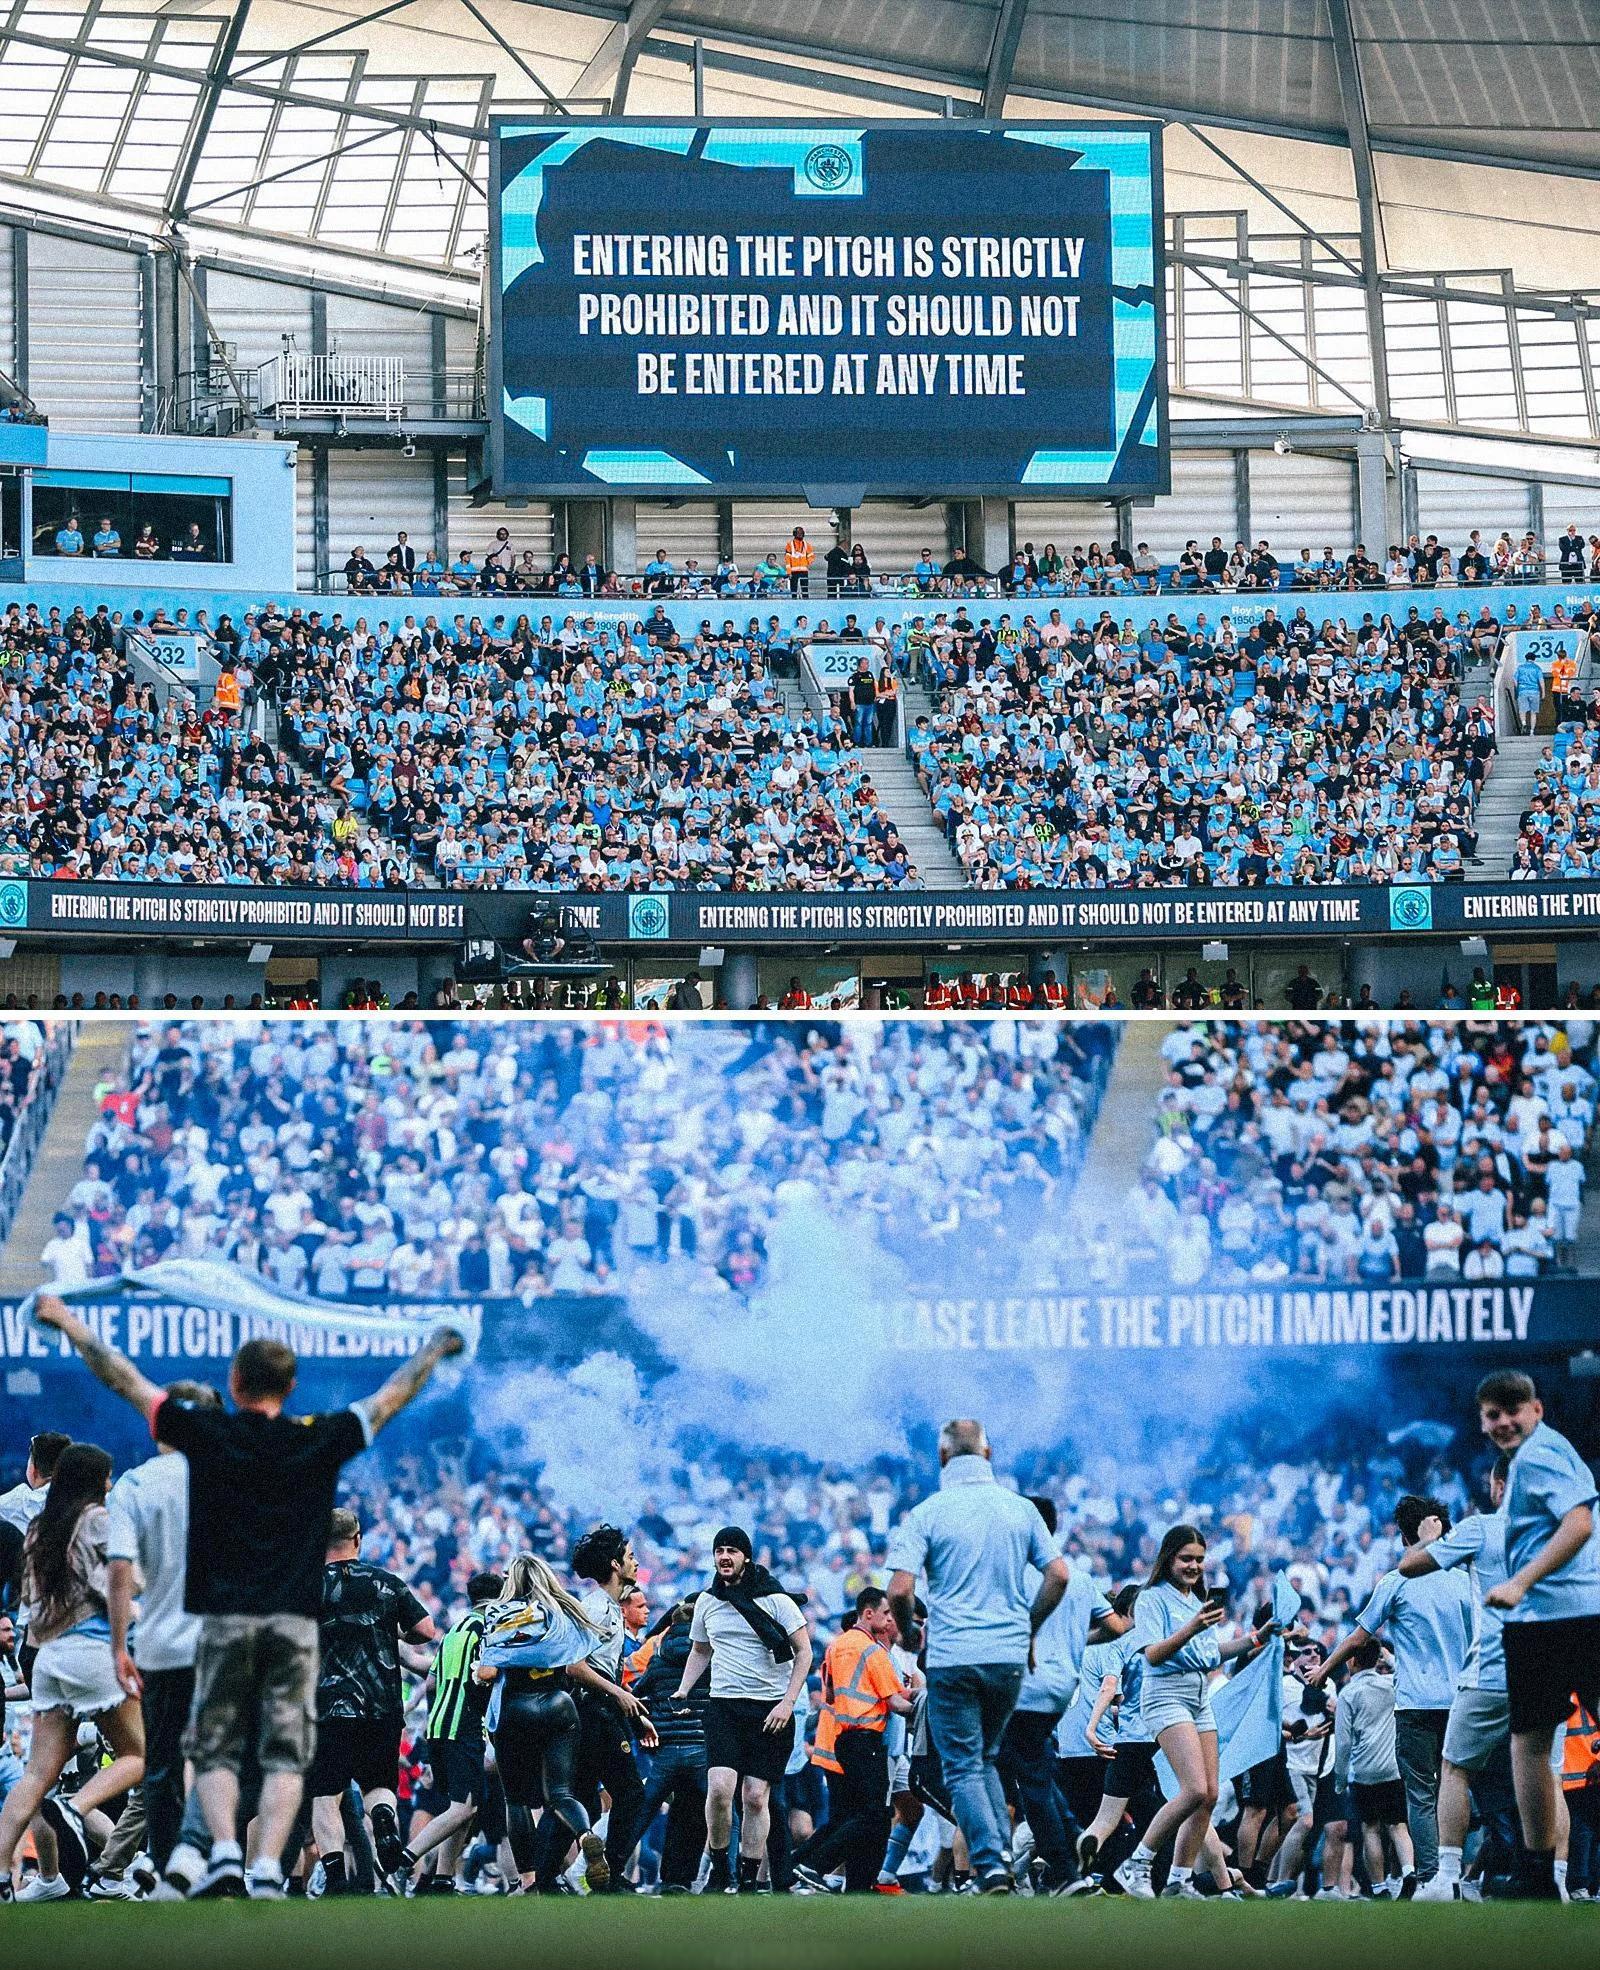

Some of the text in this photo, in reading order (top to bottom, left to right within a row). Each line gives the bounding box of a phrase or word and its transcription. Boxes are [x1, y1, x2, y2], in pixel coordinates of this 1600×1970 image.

[574, 235, 1084, 278] ENTERING THE PITCH IS STRICTLY
[578, 294, 1081, 338] PROHIBITED AND IT SHOULD NOT
[637, 353, 1026, 397] BE ENTERED AT ANY TIME
[152, 647, 185, 664] 232
[825, 656, 860, 672] 233
[1529, 641, 1564, 659] 234
[51, 894, 107, 919] ENTERING
[109, 896, 131, 920] THE
[132, 897, 167, 921] PITCH
[169, 898, 181, 922] IS
[184, 899, 239, 923] STRICTLY
[240, 901, 311, 924] PROHIBITED
[314, 902, 340, 926] AND
[342, 903, 354, 926] IT
[356, 903, 406, 927] SHOULD
[409, 904, 437, 927] NOT
[438, 905, 456, 927] BE
[699, 899, 1360, 928] ENTERING THE PITCH IS STRICTLY PROHIBITED AND IT SHOULD NOT BE ENTERED AT ANY TIME
[1463, 895, 1538, 918] ENTERING
[1540, 894, 1570, 916] THE
[128, 1304, 232, 1357] PITCH
[983, 1298, 1091, 1350] LEAVE
[1097, 1295, 1165, 1347] THE
[1168, 1292, 1274, 1347] PITCH
[1280, 1287, 1535, 1345] IMMEDIATELY
